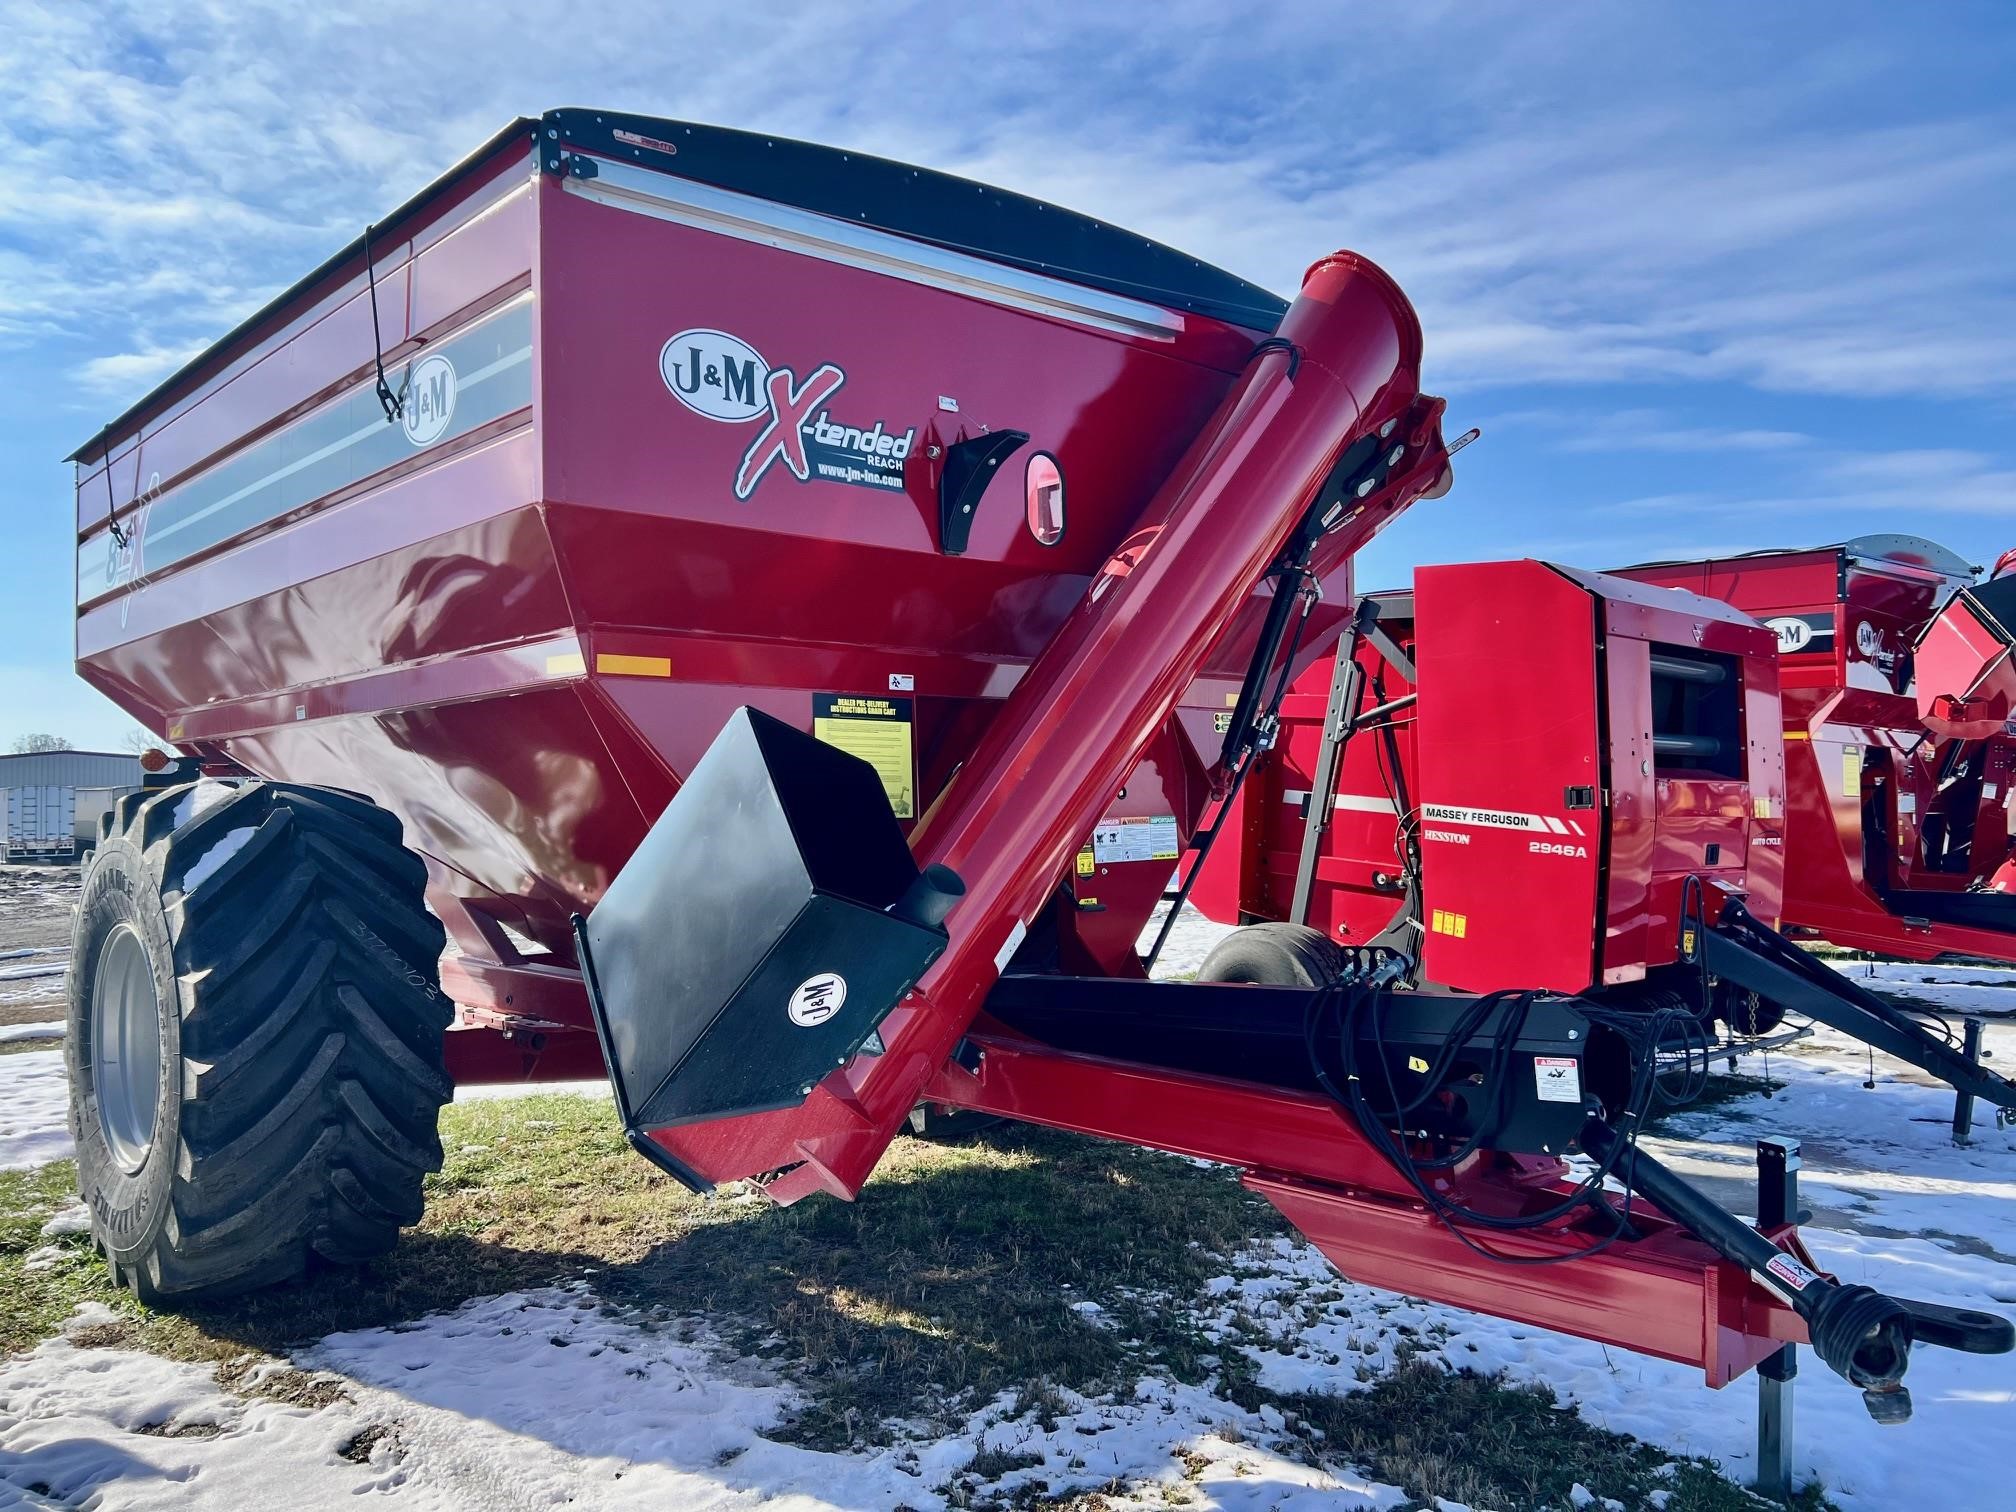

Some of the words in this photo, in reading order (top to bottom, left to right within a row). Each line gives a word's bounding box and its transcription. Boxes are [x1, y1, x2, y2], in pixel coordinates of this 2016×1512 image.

[672, 346, 757, 407] J&M
[406, 369, 448, 431] J&M
[867, 454, 903, 471] REACH
[818, 463, 902, 488] www.jm-inc.com
[1426, 808, 1468, 821] MASSEY
[1471, 812, 1529, 827] FERGUSON
[1424, 829, 1470, 845] HESSTON
[1529, 841, 1587, 859] 2946A
[802, 980, 834, 1020] J&M
[1769, 1260, 1798, 1285] DANGER
